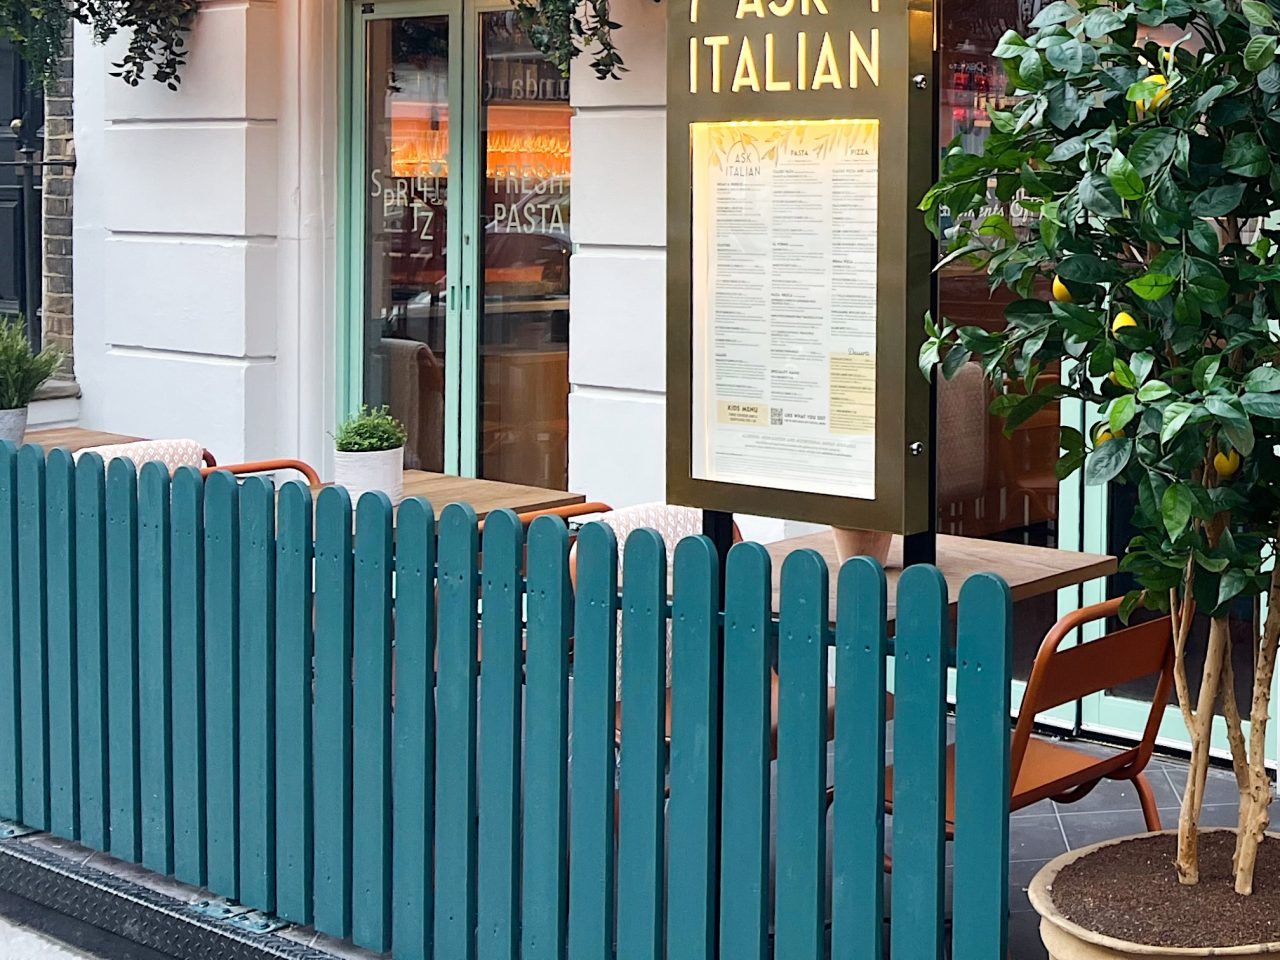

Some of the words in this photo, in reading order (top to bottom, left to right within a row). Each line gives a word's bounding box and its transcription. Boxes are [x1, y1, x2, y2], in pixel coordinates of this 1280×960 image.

[689, 28, 880, 95] ITALIAN
[734, 152, 751, 164] ASK
[790, 149, 809, 157] PASTA
[494, 164, 564, 195] FRESH
[725, 166, 761, 177] ITALIAN
[494, 203, 565, 234] PASTA
